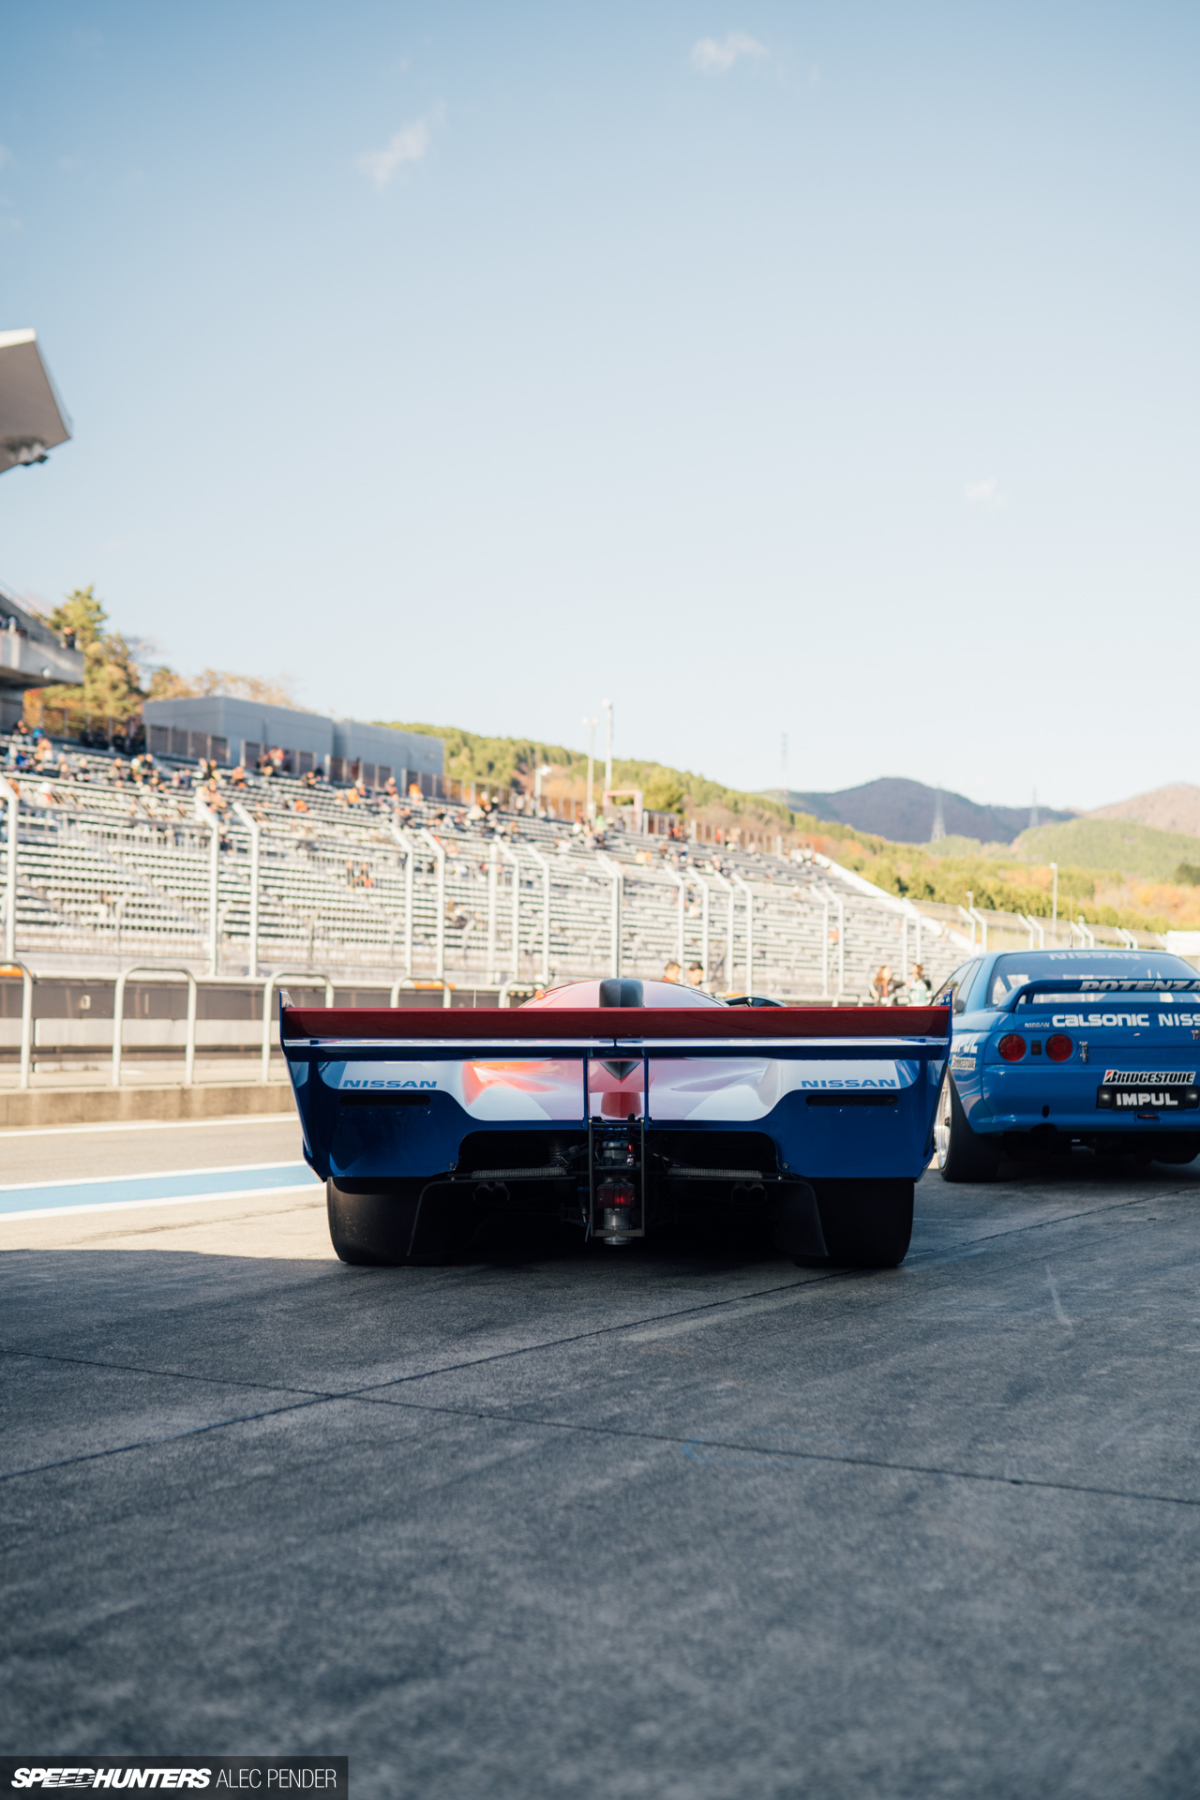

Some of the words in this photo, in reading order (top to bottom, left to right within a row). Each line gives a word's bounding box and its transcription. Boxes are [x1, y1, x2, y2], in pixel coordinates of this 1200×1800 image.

[1050, 952, 1141, 960] NISSAN
[1079, 980, 1200, 992] POTENZA
[1103, 1070, 1196, 1084] BRIDGESTONE
[342, 1080, 437, 1089] NISSAN
[801, 1079, 897, 1088] NISSAN
[1116, 1093, 1178, 1106] IMPUL
